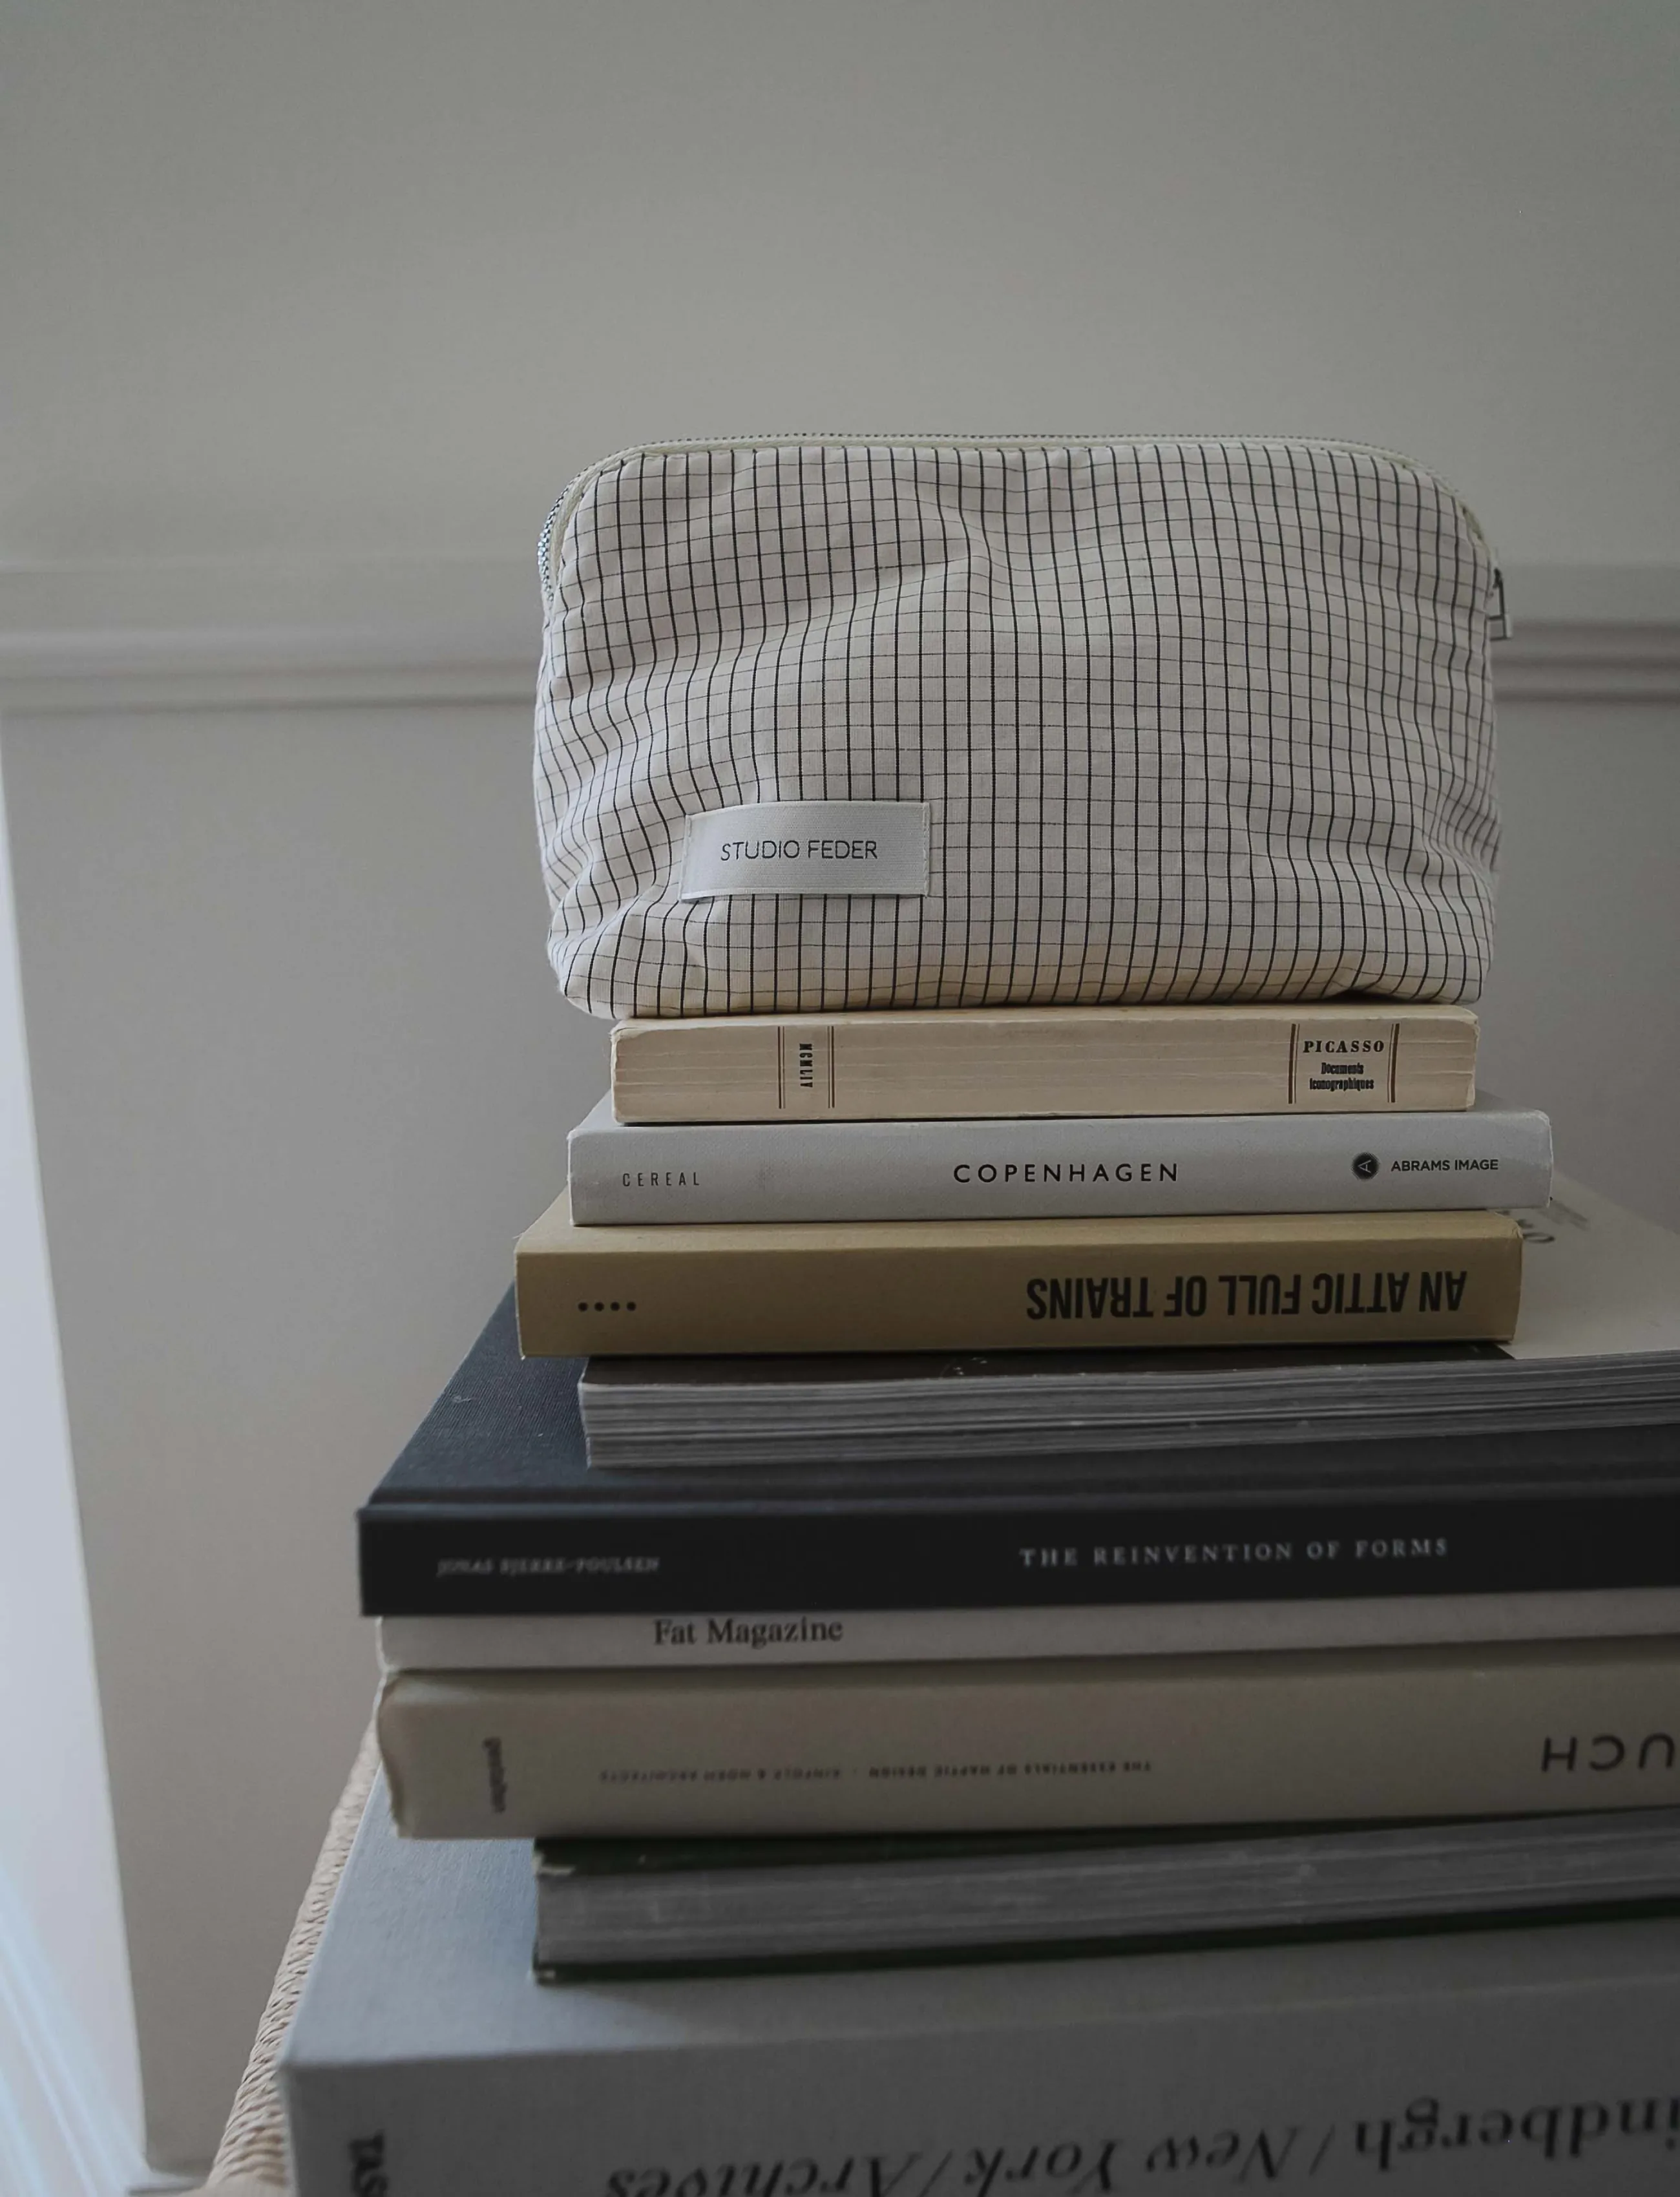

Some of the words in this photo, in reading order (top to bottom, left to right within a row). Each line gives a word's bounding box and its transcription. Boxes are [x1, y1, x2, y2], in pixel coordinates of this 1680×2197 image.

[720, 840, 801, 861] STUDIO
[808, 840, 877, 859] FEDER
[1303, 1040, 1384, 1053] PICASSO
[1321, 1062, 1364, 1075] Documents
[622, 1172, 700, 1187] CEREAL
[953, 1163, 1177, 1183] COPENHAGEN
[1391, 1159, 1451, 1172] ABRAMS
[1454, 1159, 1498, 1171] IMAGE
[1026, 1277, 1154, 1320] TRAINS
[1163, 1276, 1207, 1318] OF
[1218, 1274, 1301, 1316] FULL
[1312, 1272, 1410, 1315] ATTIC
[1418, 1270, 1467, 1312] AN
[1019, 1547, 1077, 1567] THE
[1093, 1542, 1292, 1566] REINVENTION
[1305, 1540, 1340, 1561] OF
[1354, 1537, 1447, 1559] FORMS
[654, 1618, 697, 1645] Fat
[708, 1615, 844, 1650] Magazine
[962, 2138, 1122, 2197] York
[1145, 2125, 1302, 2183] New
